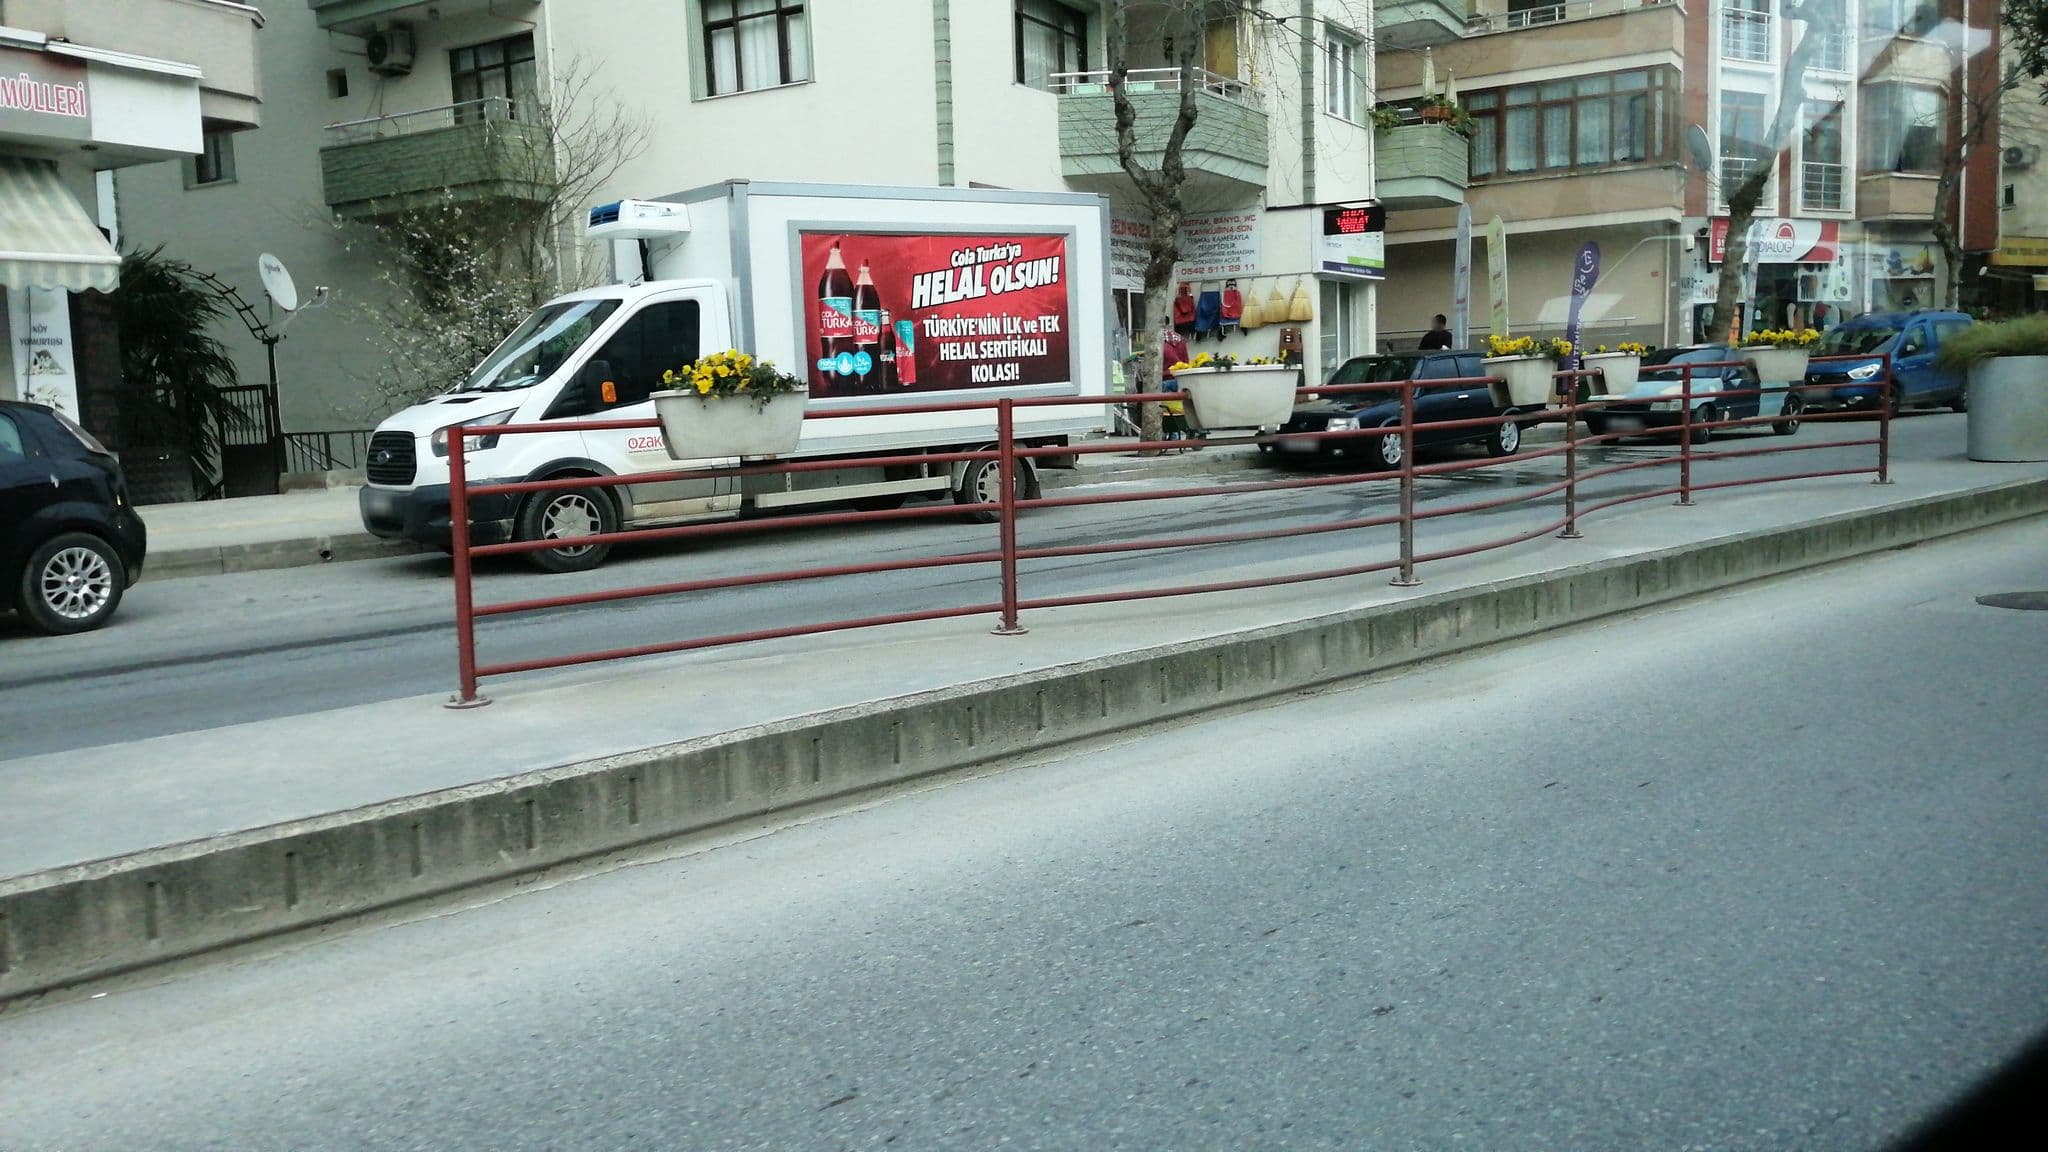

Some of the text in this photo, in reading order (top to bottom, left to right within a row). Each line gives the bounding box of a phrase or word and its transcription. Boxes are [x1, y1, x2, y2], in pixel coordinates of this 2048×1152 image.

[951, 242, 1022, 267] Cola Turka'ya
[1181, 267, 1205, 275] 0542
[1207, 265, 1226, 273] 511
[1228, 264, 1241, 272] 29
[912, 256, 1060, 309] HELAL OLSUN!
[922, 312, 1060, 338] TÜRKİYE'NİN İLK ve TEK
[940, 335, 1048, 361] HELAL SERTİFİKALI
[971, 363, 1020, 383] KOLASI!
